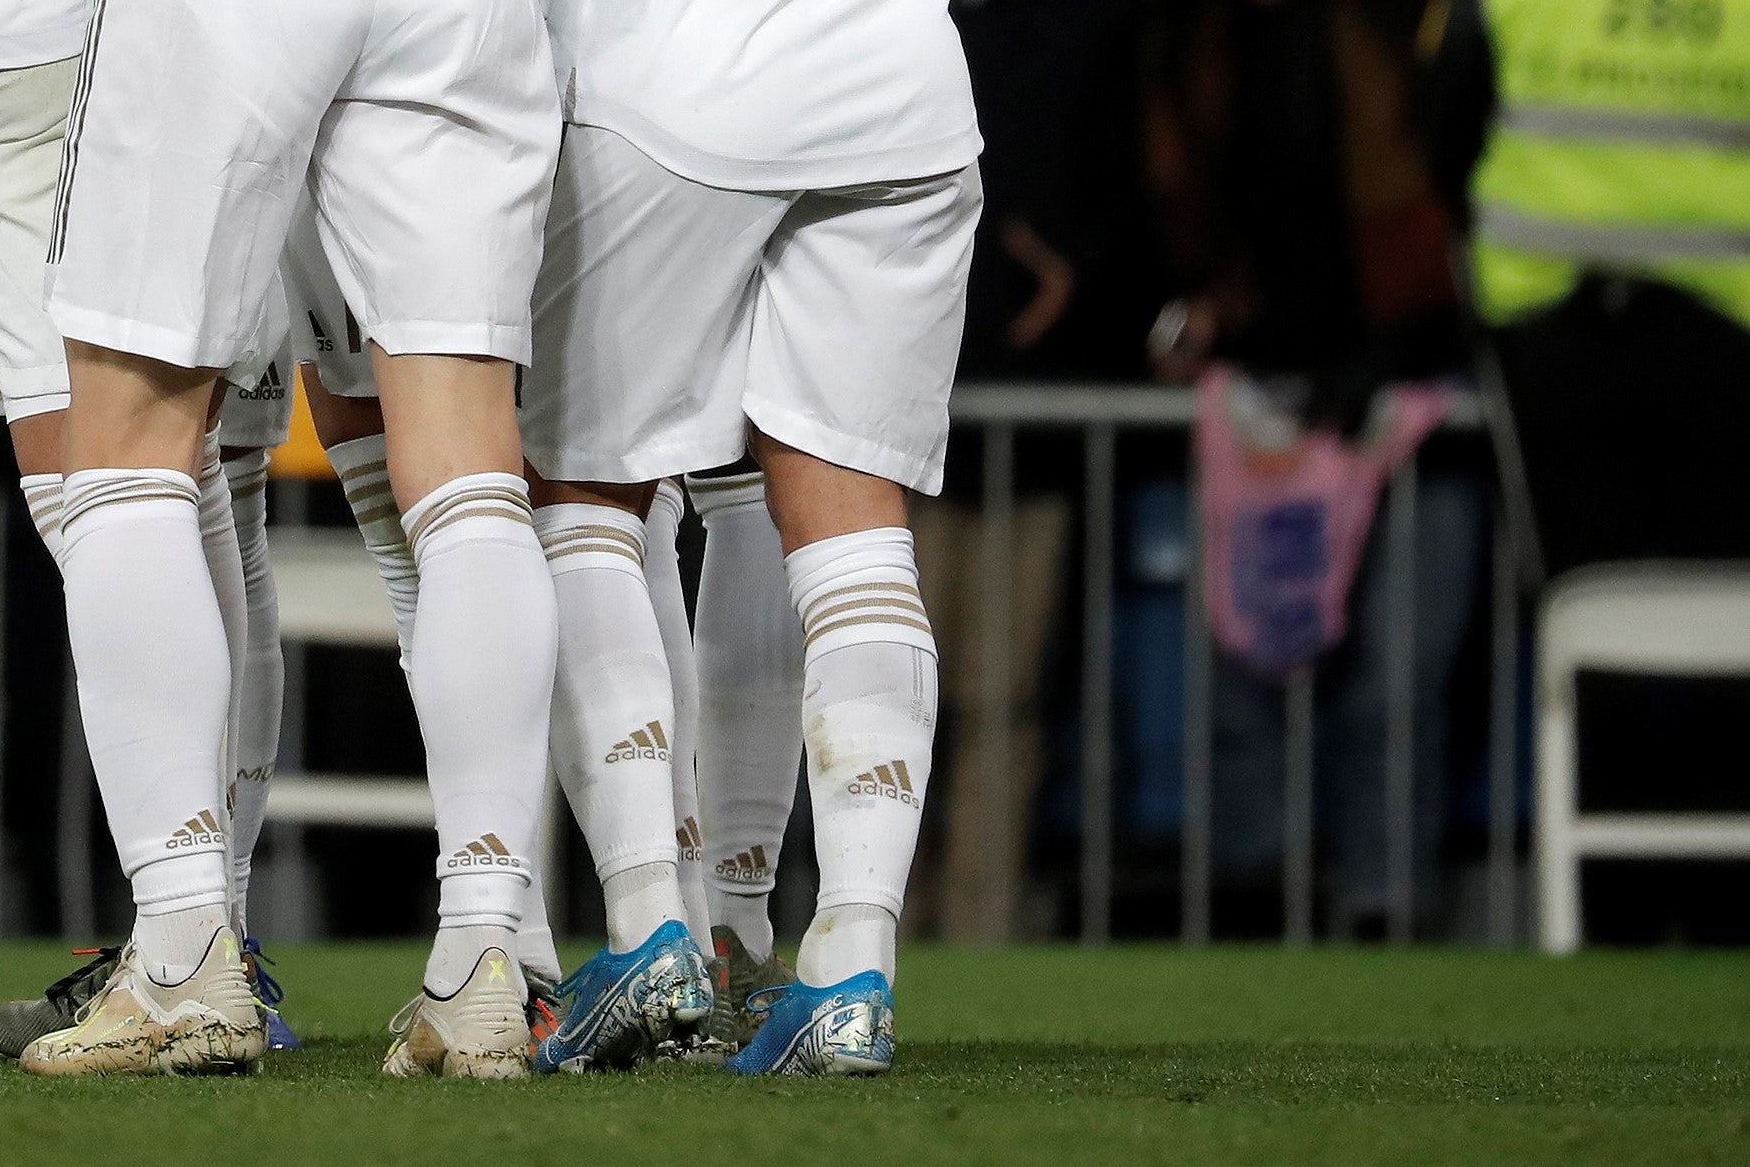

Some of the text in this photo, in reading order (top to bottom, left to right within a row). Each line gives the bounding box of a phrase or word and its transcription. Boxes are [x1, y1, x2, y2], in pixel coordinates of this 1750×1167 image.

[238, 383, 286, 401] adidas
[848, 782, 920, 810] adidas
[446, 854, 520, 868] adidas
